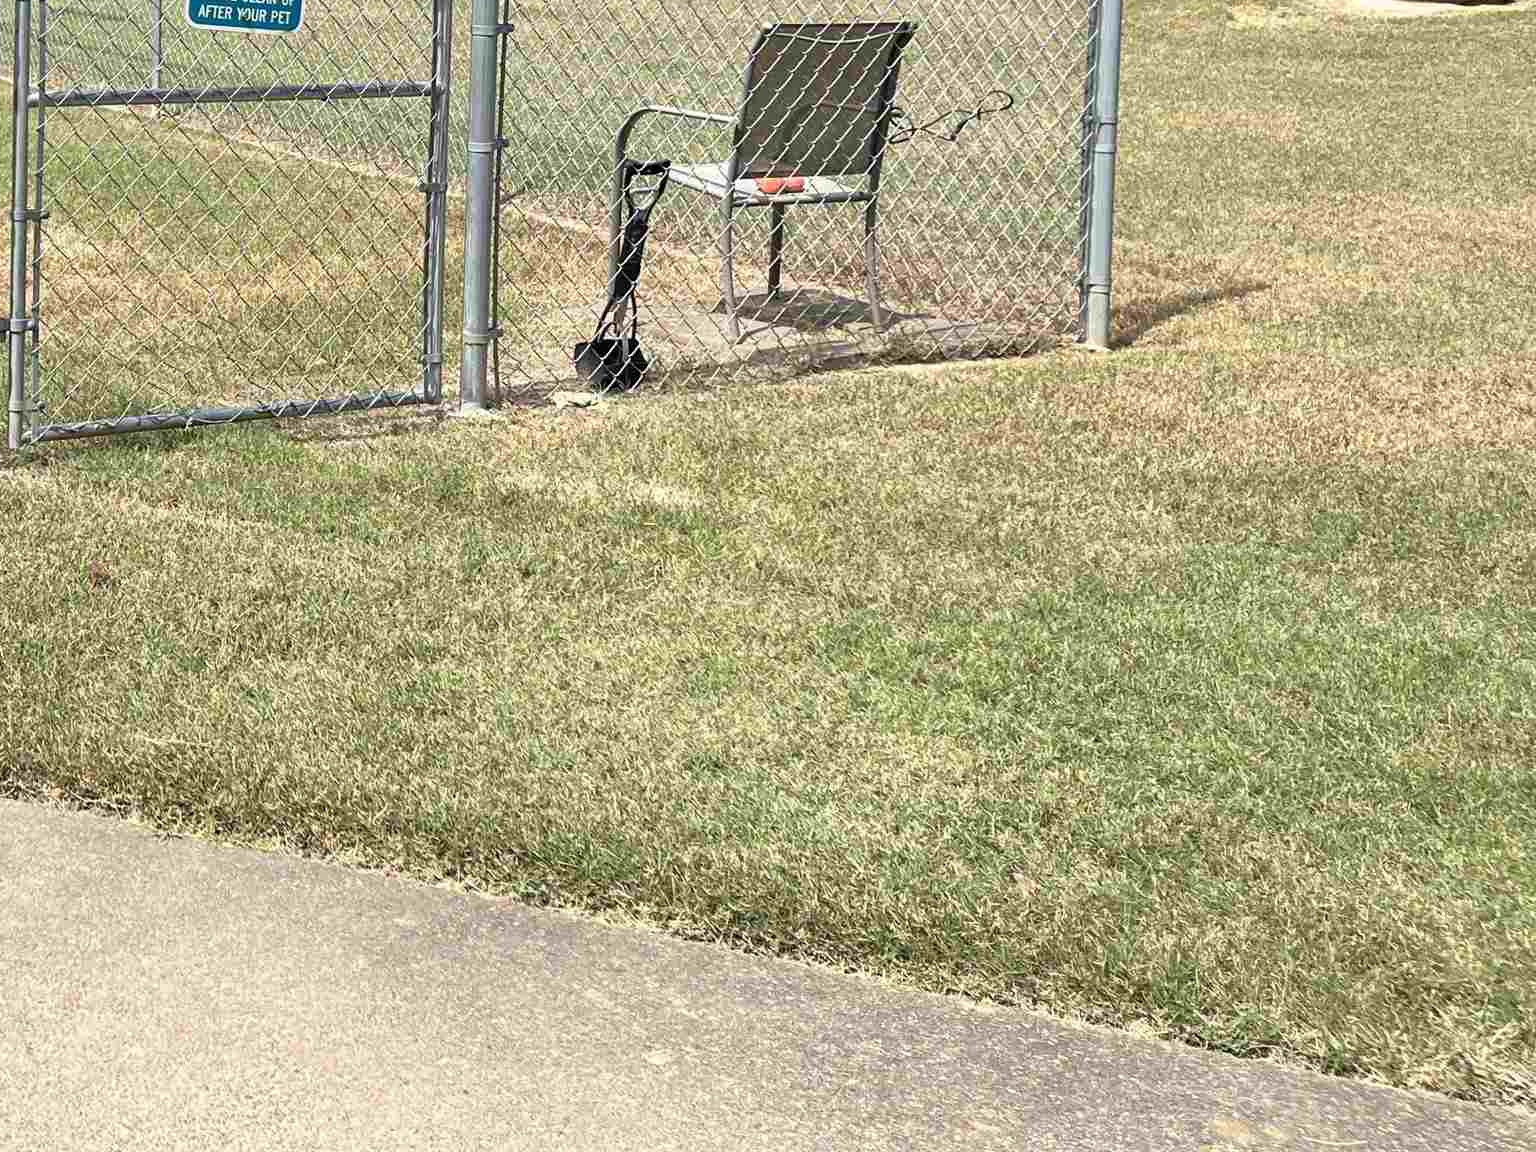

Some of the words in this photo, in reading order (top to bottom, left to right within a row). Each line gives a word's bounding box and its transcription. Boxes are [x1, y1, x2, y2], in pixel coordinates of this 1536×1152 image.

[198, 5, 231, 19] AFTER
[237, 7, 266, 22] YOUR
[271, 11, 291, 24] PET
